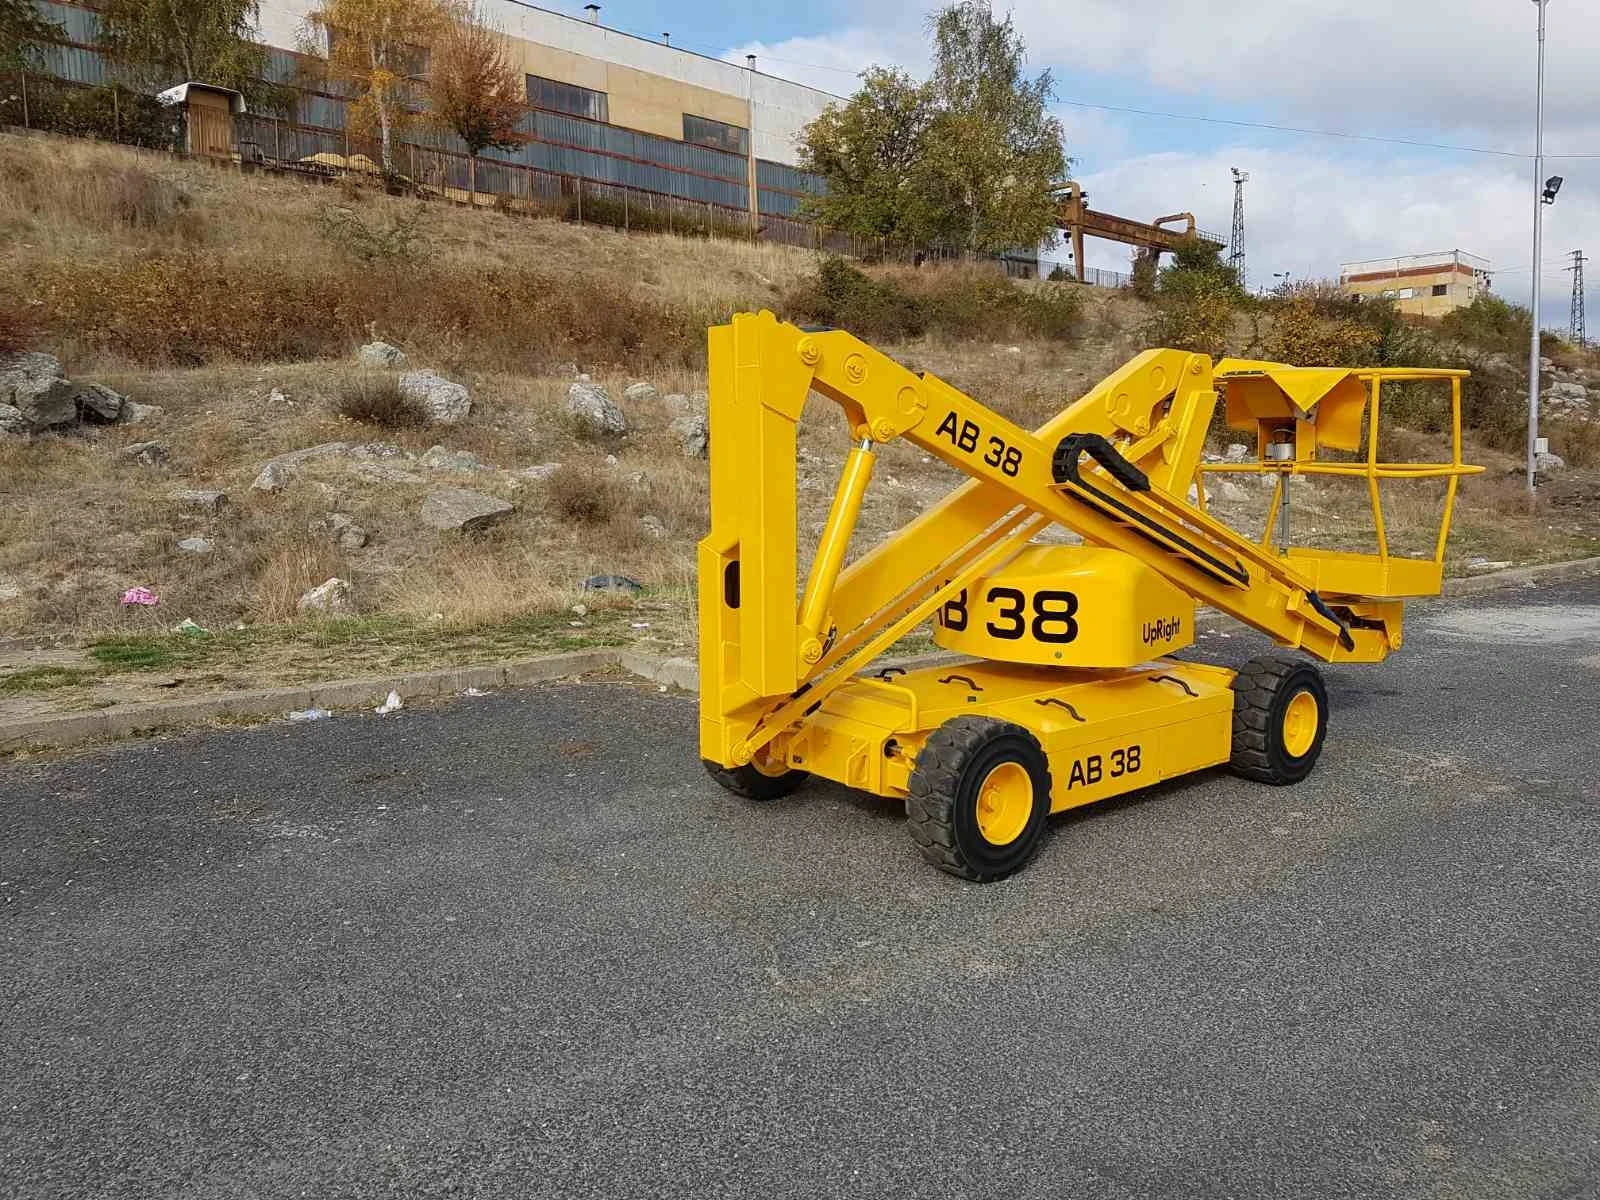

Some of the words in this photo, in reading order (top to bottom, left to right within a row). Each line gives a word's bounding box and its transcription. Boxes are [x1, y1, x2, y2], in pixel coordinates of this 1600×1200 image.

[935, 411, 980, 453] AB
[984, 436, 1023, 477] 38
[986, 587, 1079, 643] 38
[1143, 616, 1180, 647] UpRight
[1067, 755, 1102, 790] AB
[1110, 745, 1141, 777] 38
